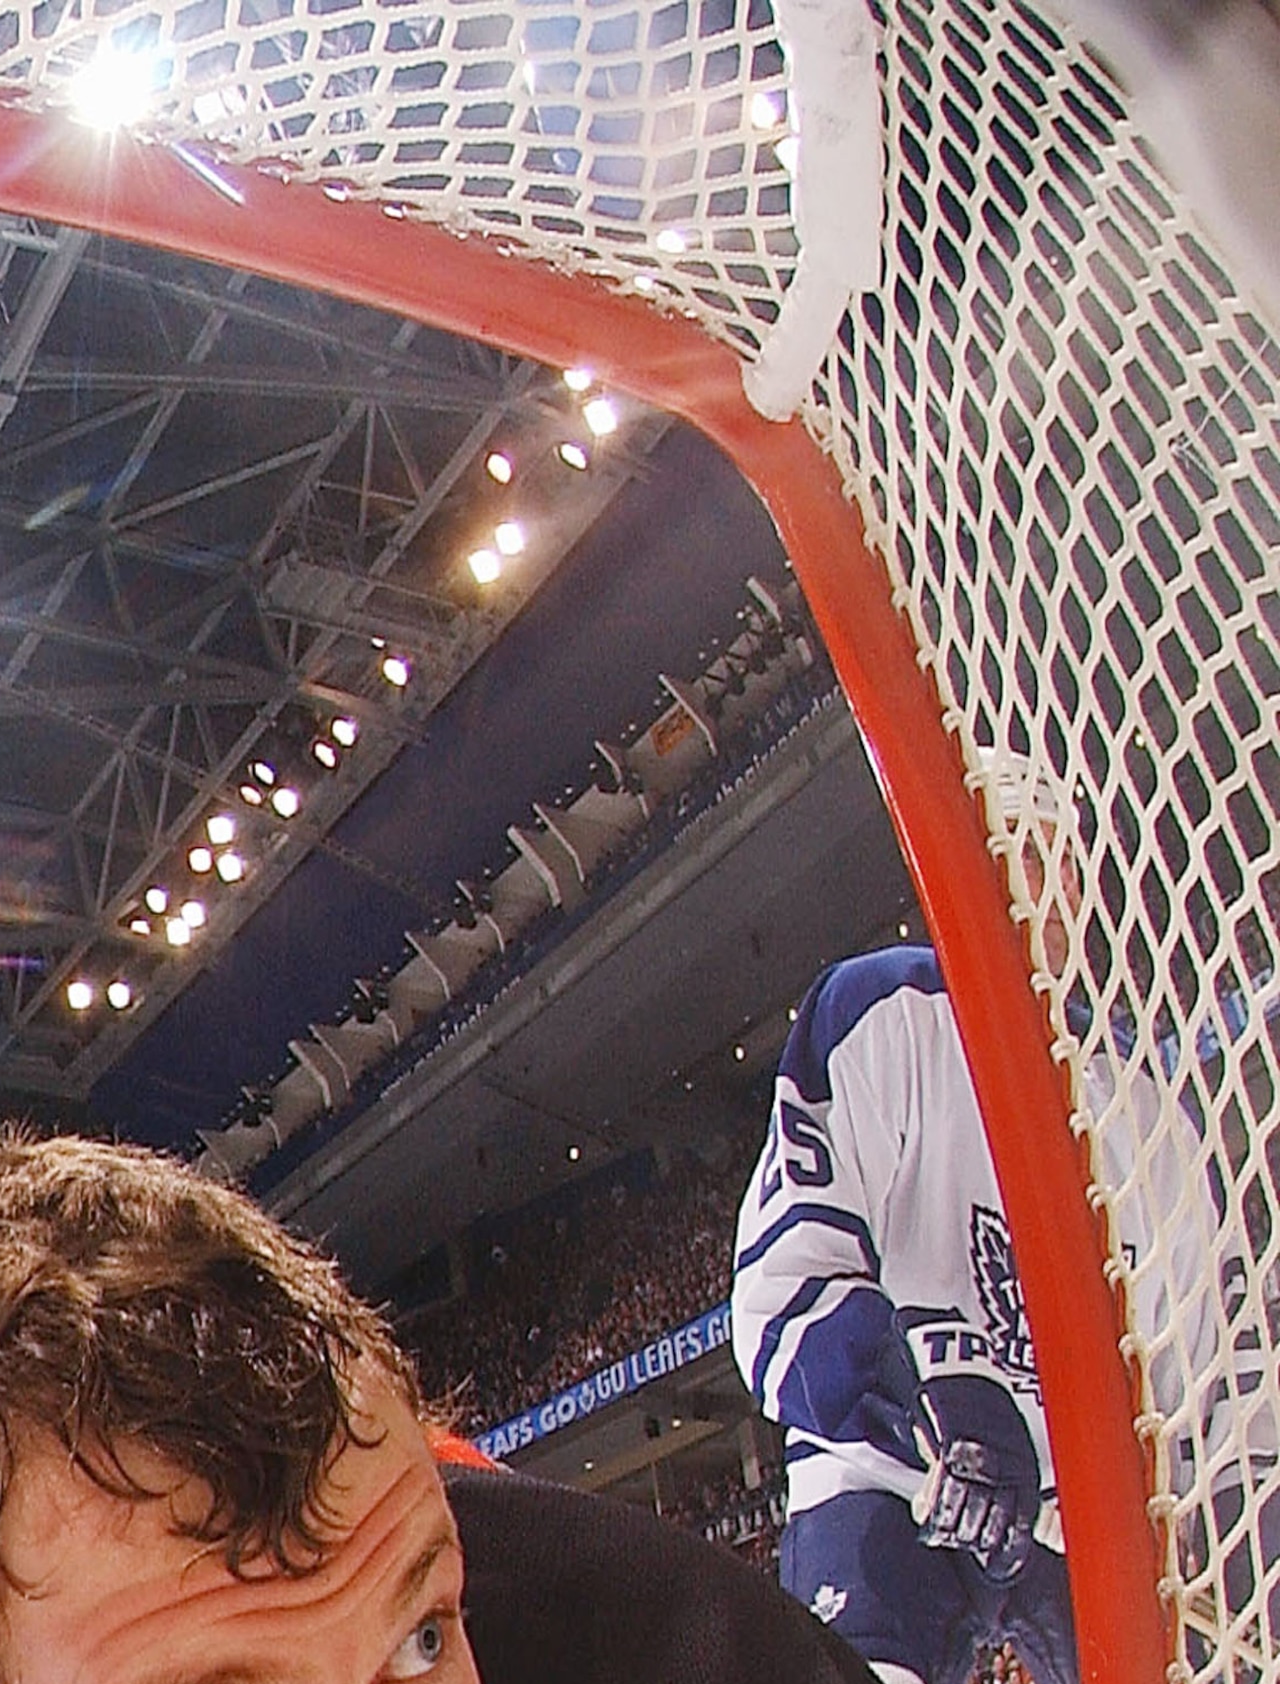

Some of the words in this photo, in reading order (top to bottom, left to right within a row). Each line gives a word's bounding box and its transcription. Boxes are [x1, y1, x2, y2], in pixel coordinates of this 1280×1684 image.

[538, 1396, 577, 1431] GO
[595, 1362, 626, 1400] GO
[631, 1325, 704, 1384] LEAFS
